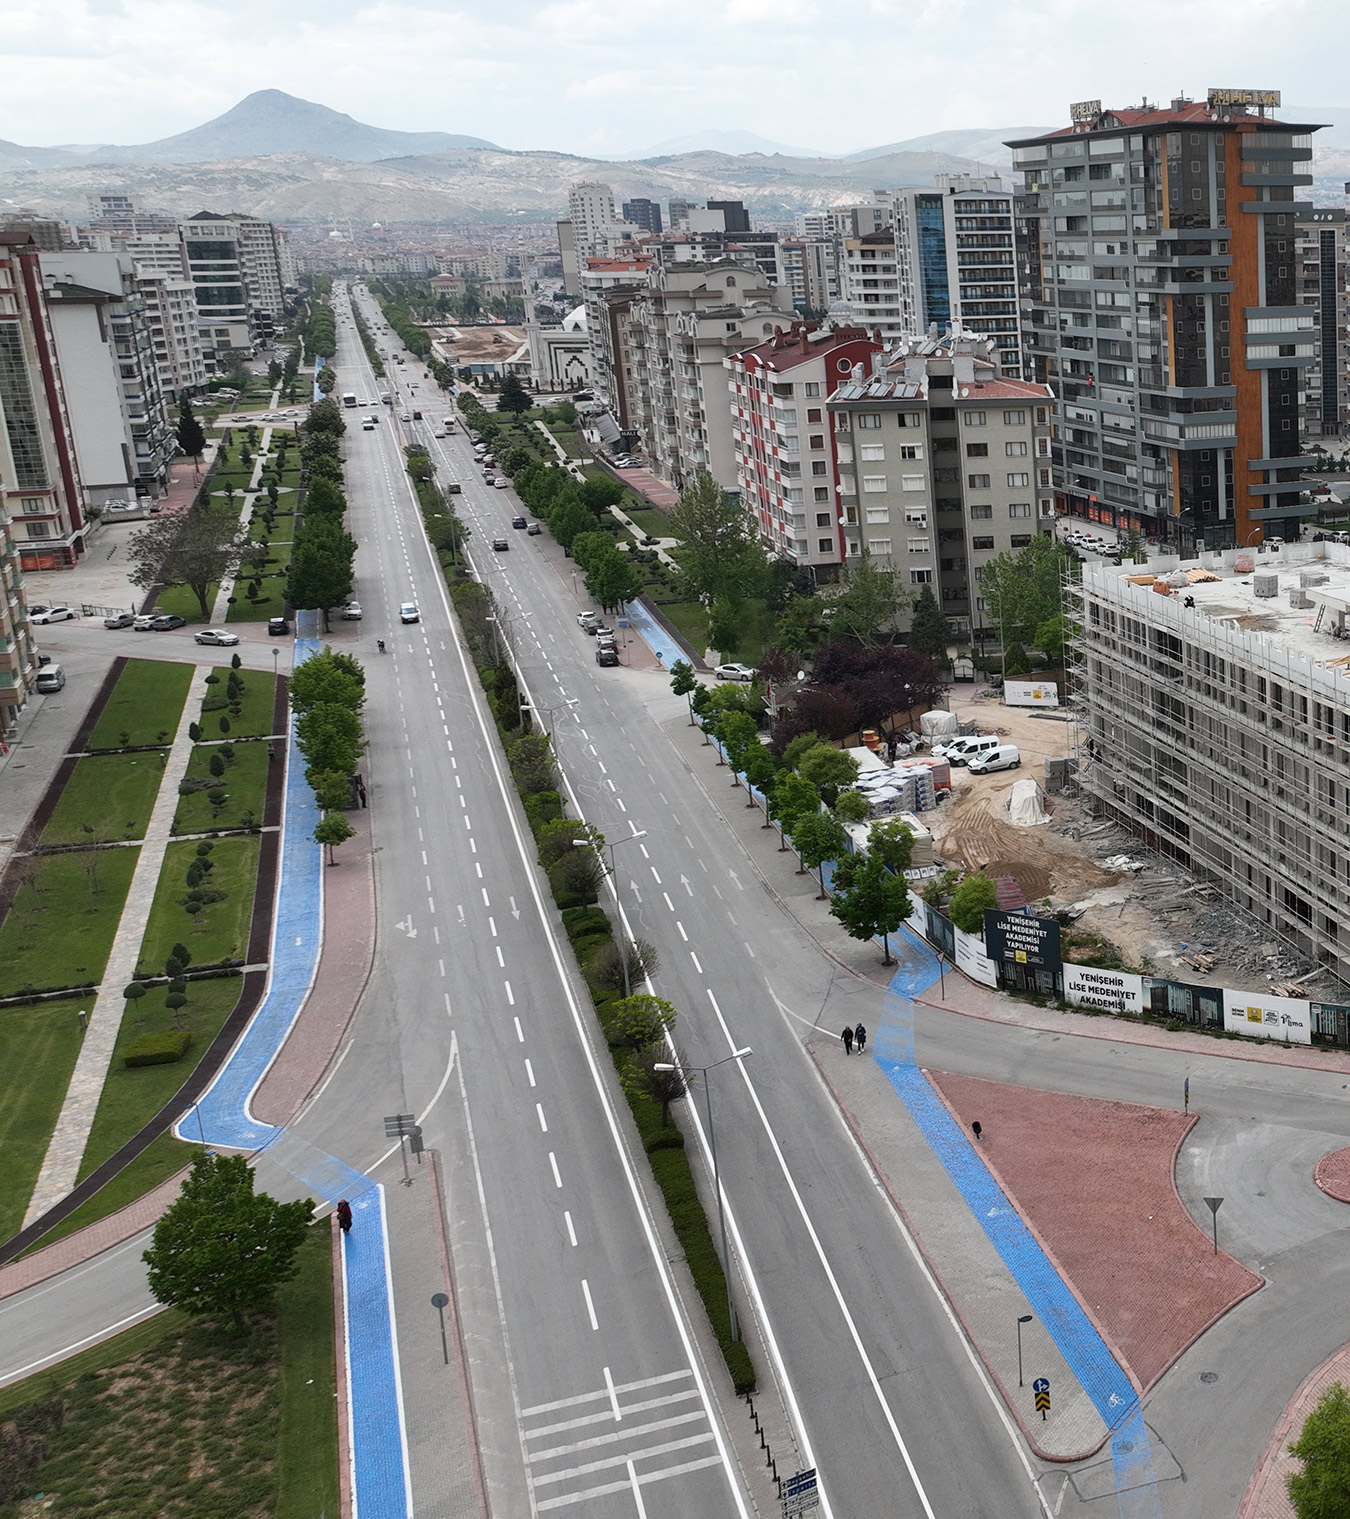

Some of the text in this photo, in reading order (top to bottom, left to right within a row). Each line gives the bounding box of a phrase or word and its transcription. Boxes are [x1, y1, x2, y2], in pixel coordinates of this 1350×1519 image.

[1006, 915, 1040, 928] YENİŞEHİR
[997, 922, 1048, 938] LİSE MEDENİYET
[1005, 932, 1040, 944] AKADEMİSİ
[1006, 940, 1040, 953] YAPILIYOR
[1079, 972, 1124, 987] YENİŞEHİR
[1069, 981, 1136, 1000] LİSE MEDENİYET
[1080, 996, 1126, 1010] AKADEMİSİ
